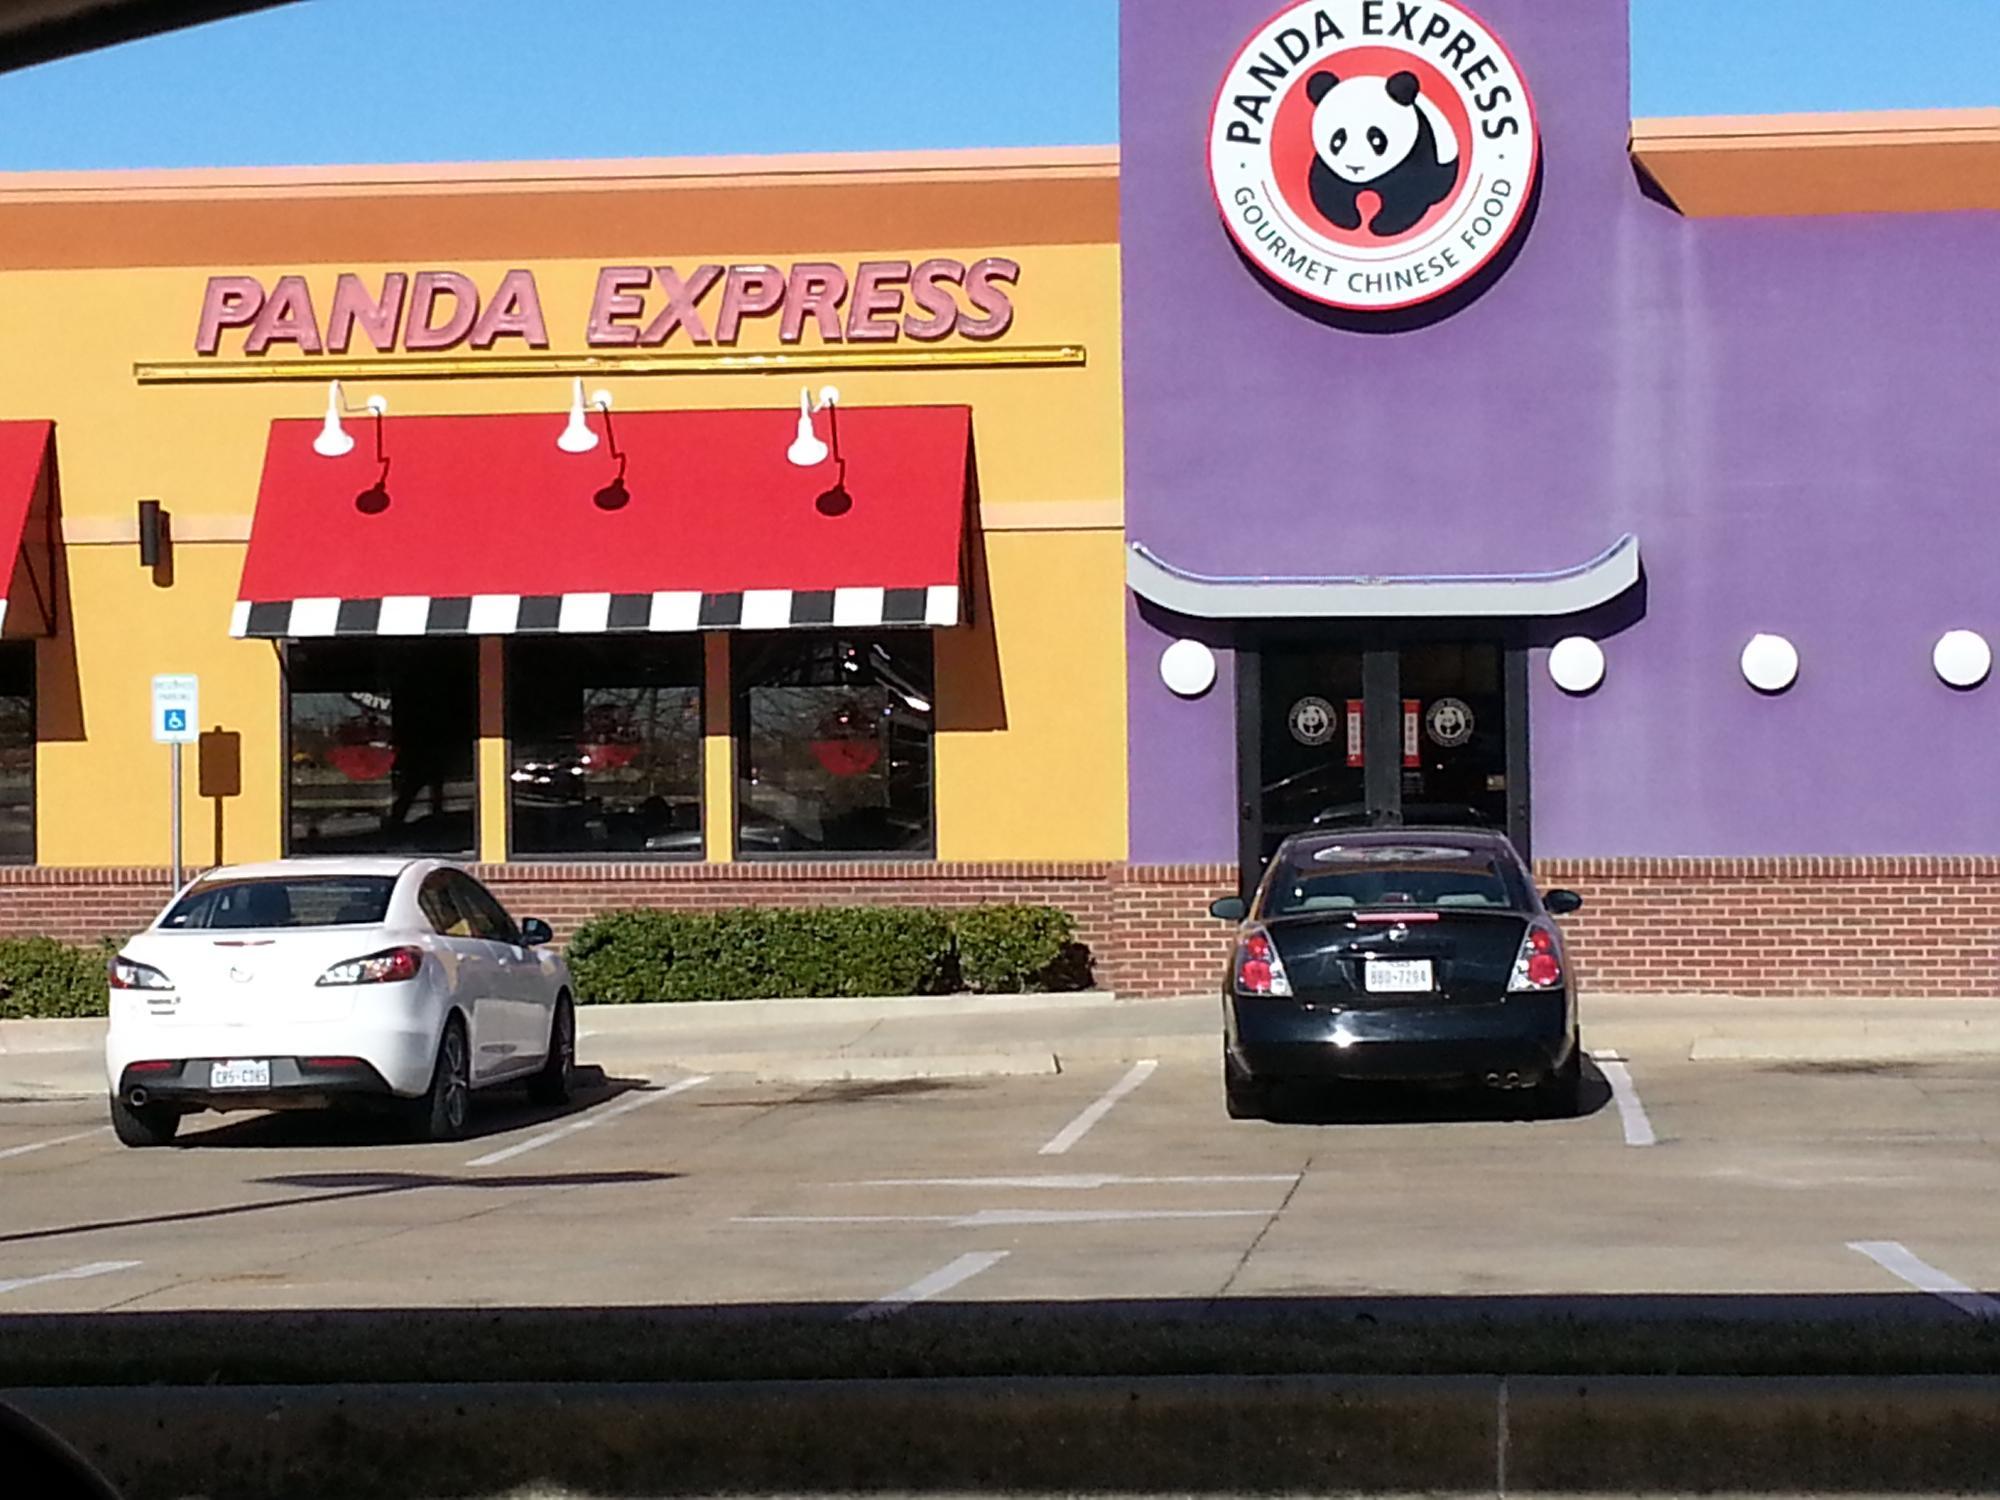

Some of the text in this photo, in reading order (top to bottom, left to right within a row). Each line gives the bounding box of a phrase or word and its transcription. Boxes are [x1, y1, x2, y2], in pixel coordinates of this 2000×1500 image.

[1226, 0, 1519, 145] PANDA EXPRESS
[1234, 179, 1512, 293] GOURMET CHINESE FOOD
[194, 257, 1020, 357] PANDA EXPRESS
